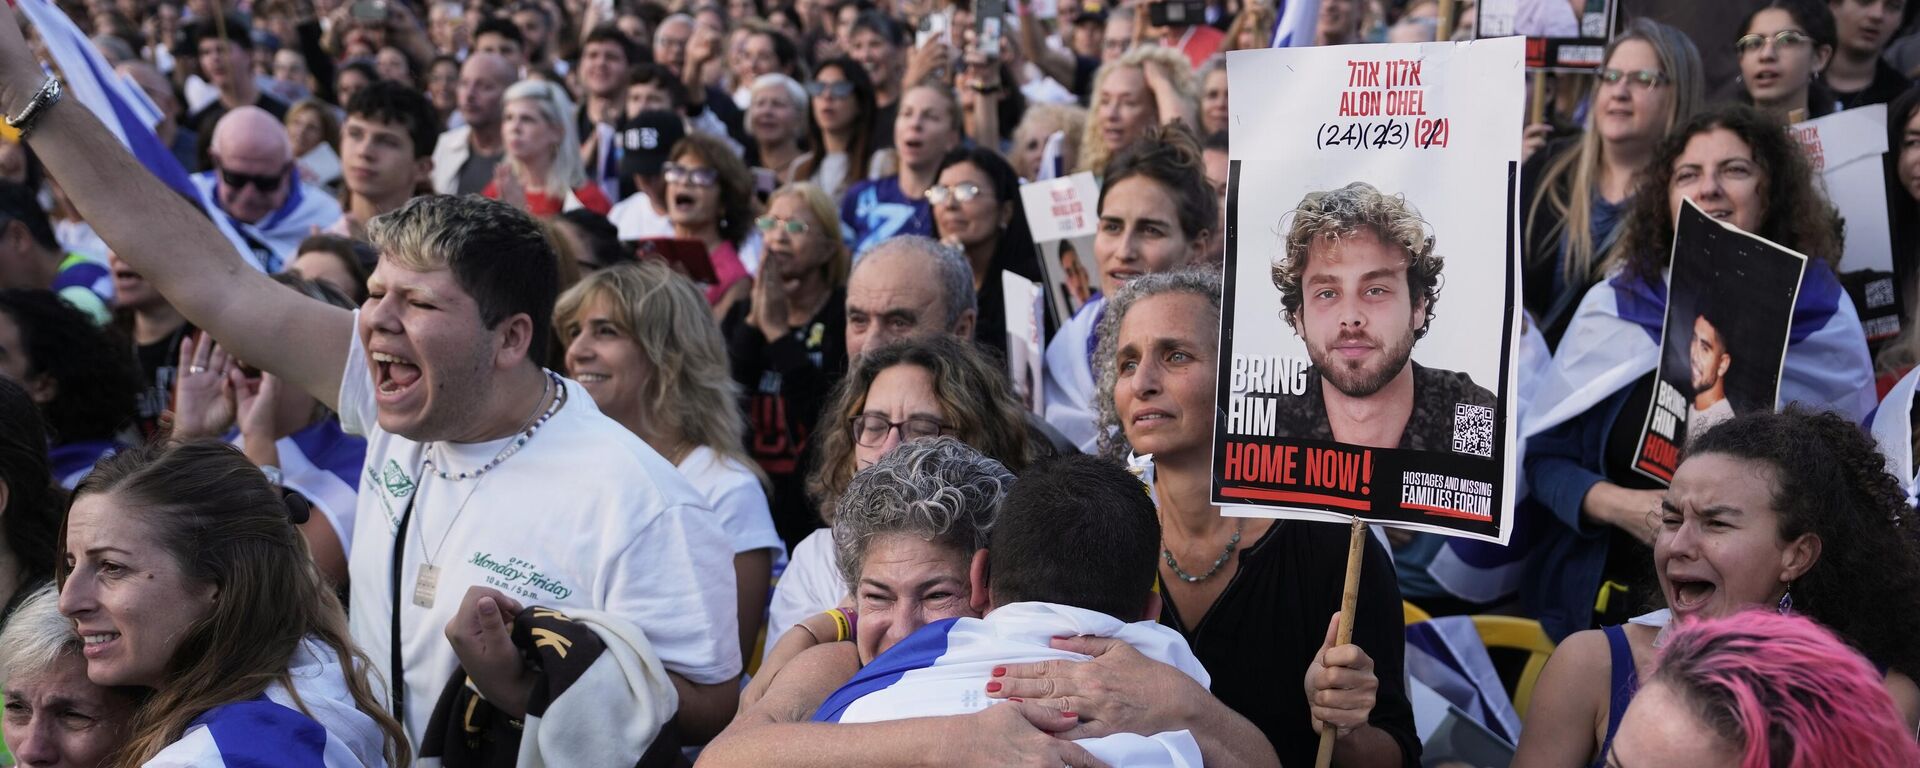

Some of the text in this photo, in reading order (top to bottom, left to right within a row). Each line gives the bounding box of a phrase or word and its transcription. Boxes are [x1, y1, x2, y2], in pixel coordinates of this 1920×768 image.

[1348, 59, 1421, 89] אלון אהל
[1339, 90, 1426, 116] ALON OHEL
[1232, 354, 1308, 396] BRING
[1227, 396, 1277, 437] HIM
[1657, 379, 1687, 422] BRING
[1651, 405, 1676, 441] HIM
[1224, 442, 1372, 496] HOME NOW!
[1402, 471, 1493, 497] HOSTAGES AND MISSING
[1401, 485, 1492, 517] FAMILIES FORUM
[468, 551, 573, 600] Monday-Friday
[485, 575, 496, 584] 10
[495, 579, 509, 590] a.m.
[516, 586, 522, 594] 5
[522, 589, 539, 600] p.m.
